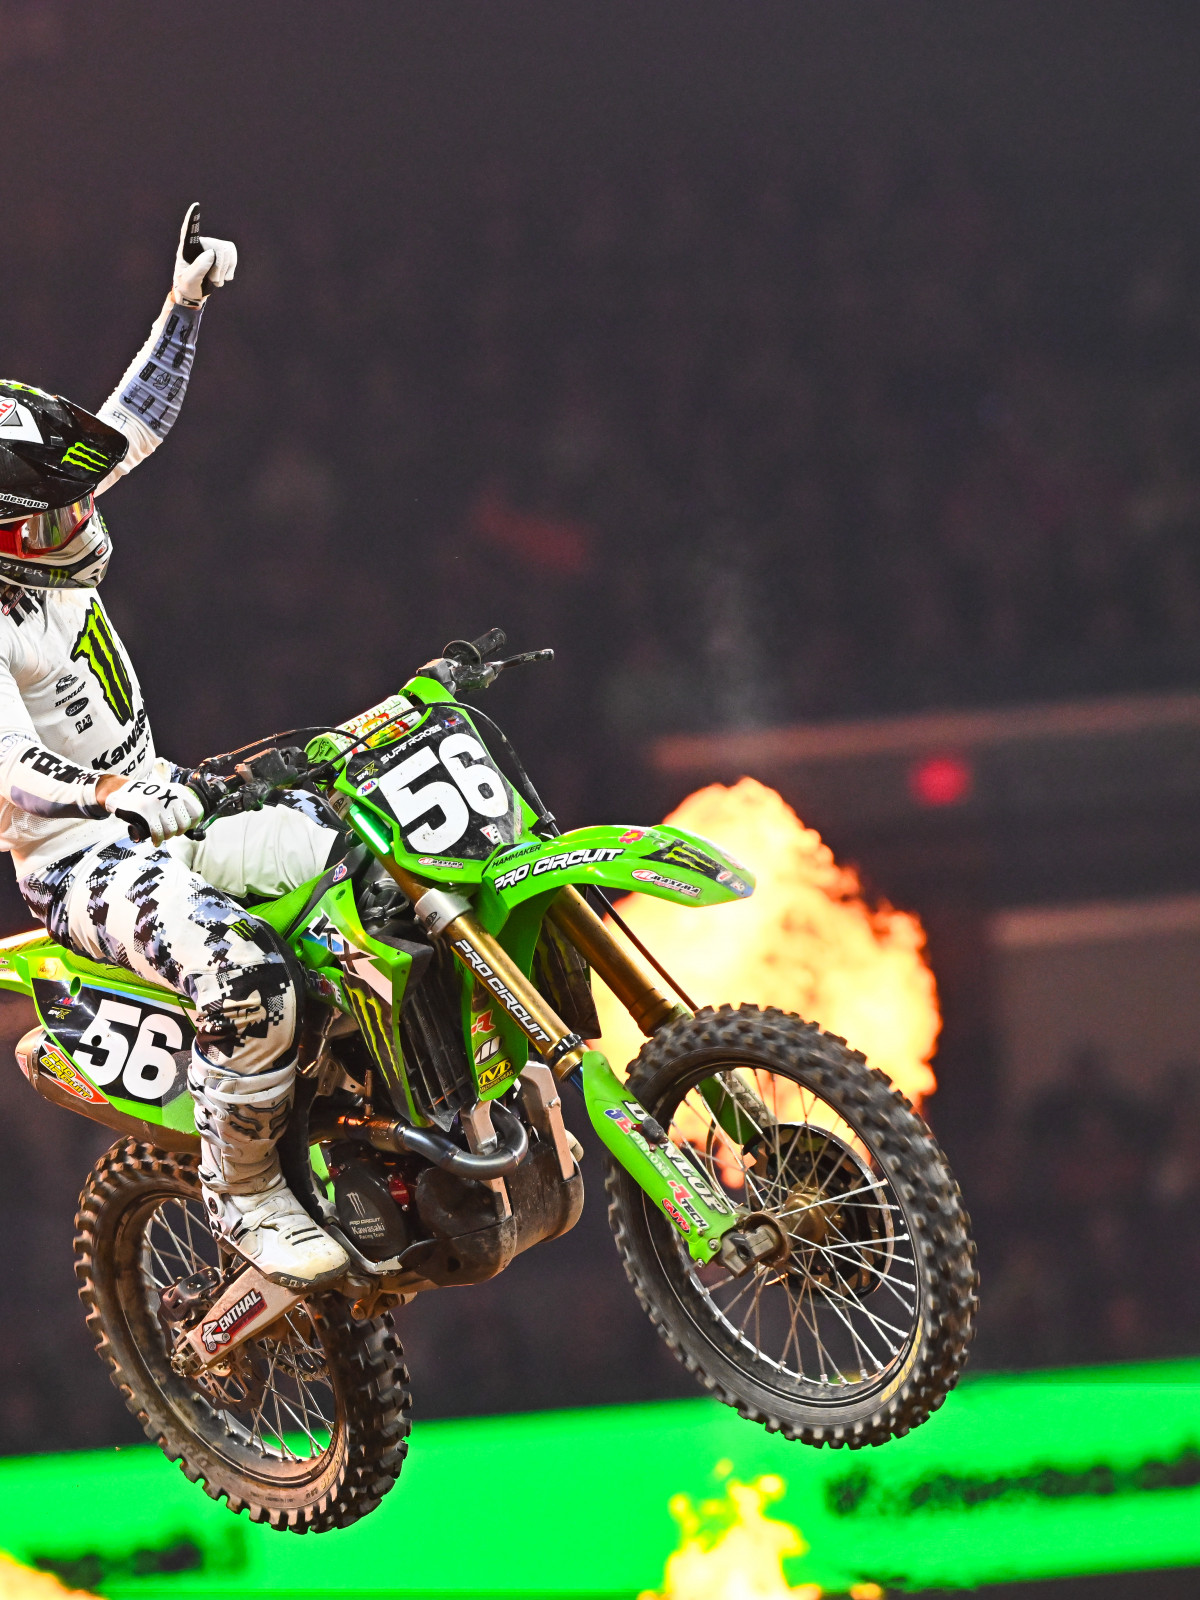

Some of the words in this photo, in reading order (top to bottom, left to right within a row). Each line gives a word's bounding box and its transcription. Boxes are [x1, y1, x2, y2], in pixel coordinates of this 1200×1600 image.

[54, 681, 87, 708] DUNLOP
[380, 724, 443, 765] SUPERCROSS
[128, 781, 179, 810] FOX
[361, 780, 377, 795] AMA
[379, 733, 508, 854] 56
[490, 843, 542, 869] HAMMAKER
[494, 868, 531, 894] PRO
[532, 848, 625, 876] CIRCUIT
[454, 939, 494, 978] PRO
[486, 976, 551, 1044] CIRCUIT
[72, 998, 184, 1100] 56
[41, 1056, 92, 1098] CIRCUIT
[48, 1052, 76, 1079] PRO
[604, 1108, 633, 1134] JE
[622, 1100, 729, 1215] DNLOP
[351, 1222, 386, 1235] Kawasaki
[662, 1198, 691, 1233] GUTS
[279, 1276, 309, 1289] FOX
